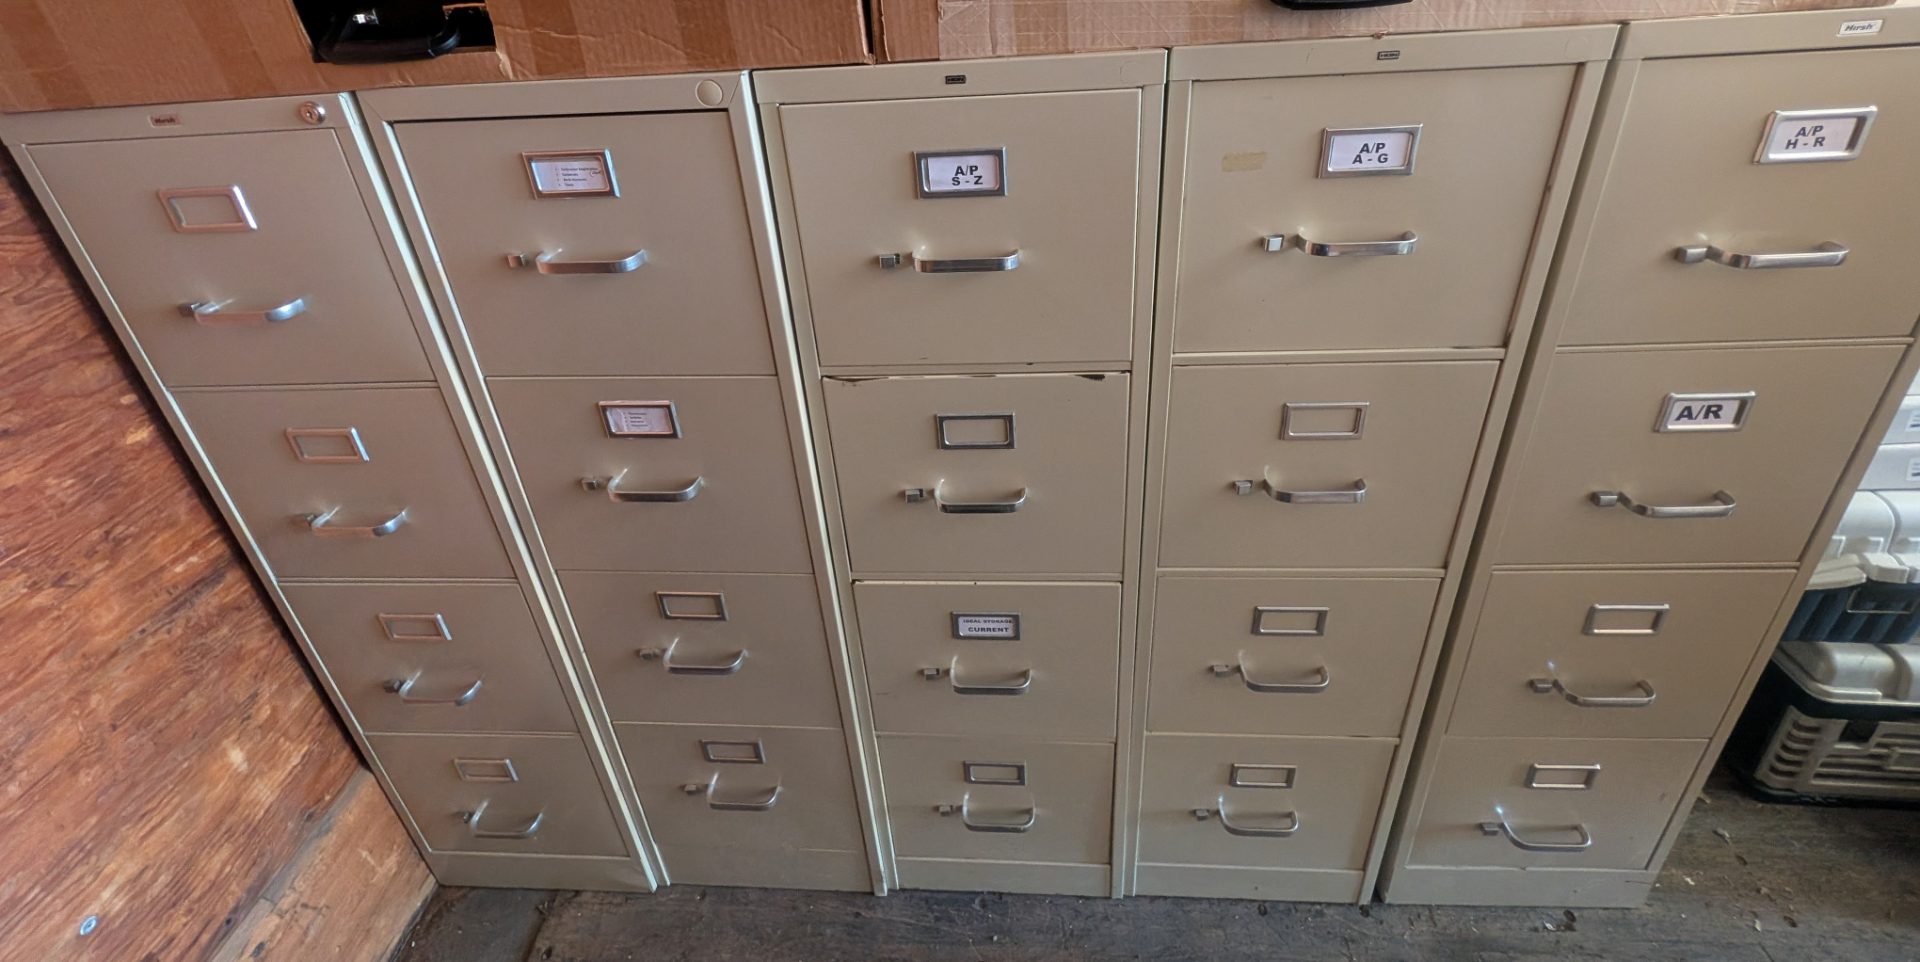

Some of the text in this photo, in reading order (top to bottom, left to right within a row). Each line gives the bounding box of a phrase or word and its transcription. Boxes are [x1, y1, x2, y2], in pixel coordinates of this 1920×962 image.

[1844, 23, 1873, 32] Hirsh
[1795, 125, 1824, 138] A/P
[1359, 142, 1386, 154] A/P
[1785, 138, 1799, 150] H
[1813, 136, 1826, 148] R
[1352, 153, 1363, 165] A
[1377, 153, 1389, 164] G
[954, 165, 979, 177] A/P
[951, 176, 961, 186] S
[973, 175, 984, 185] Z
[1674, 404, 1723, 421] A/R
